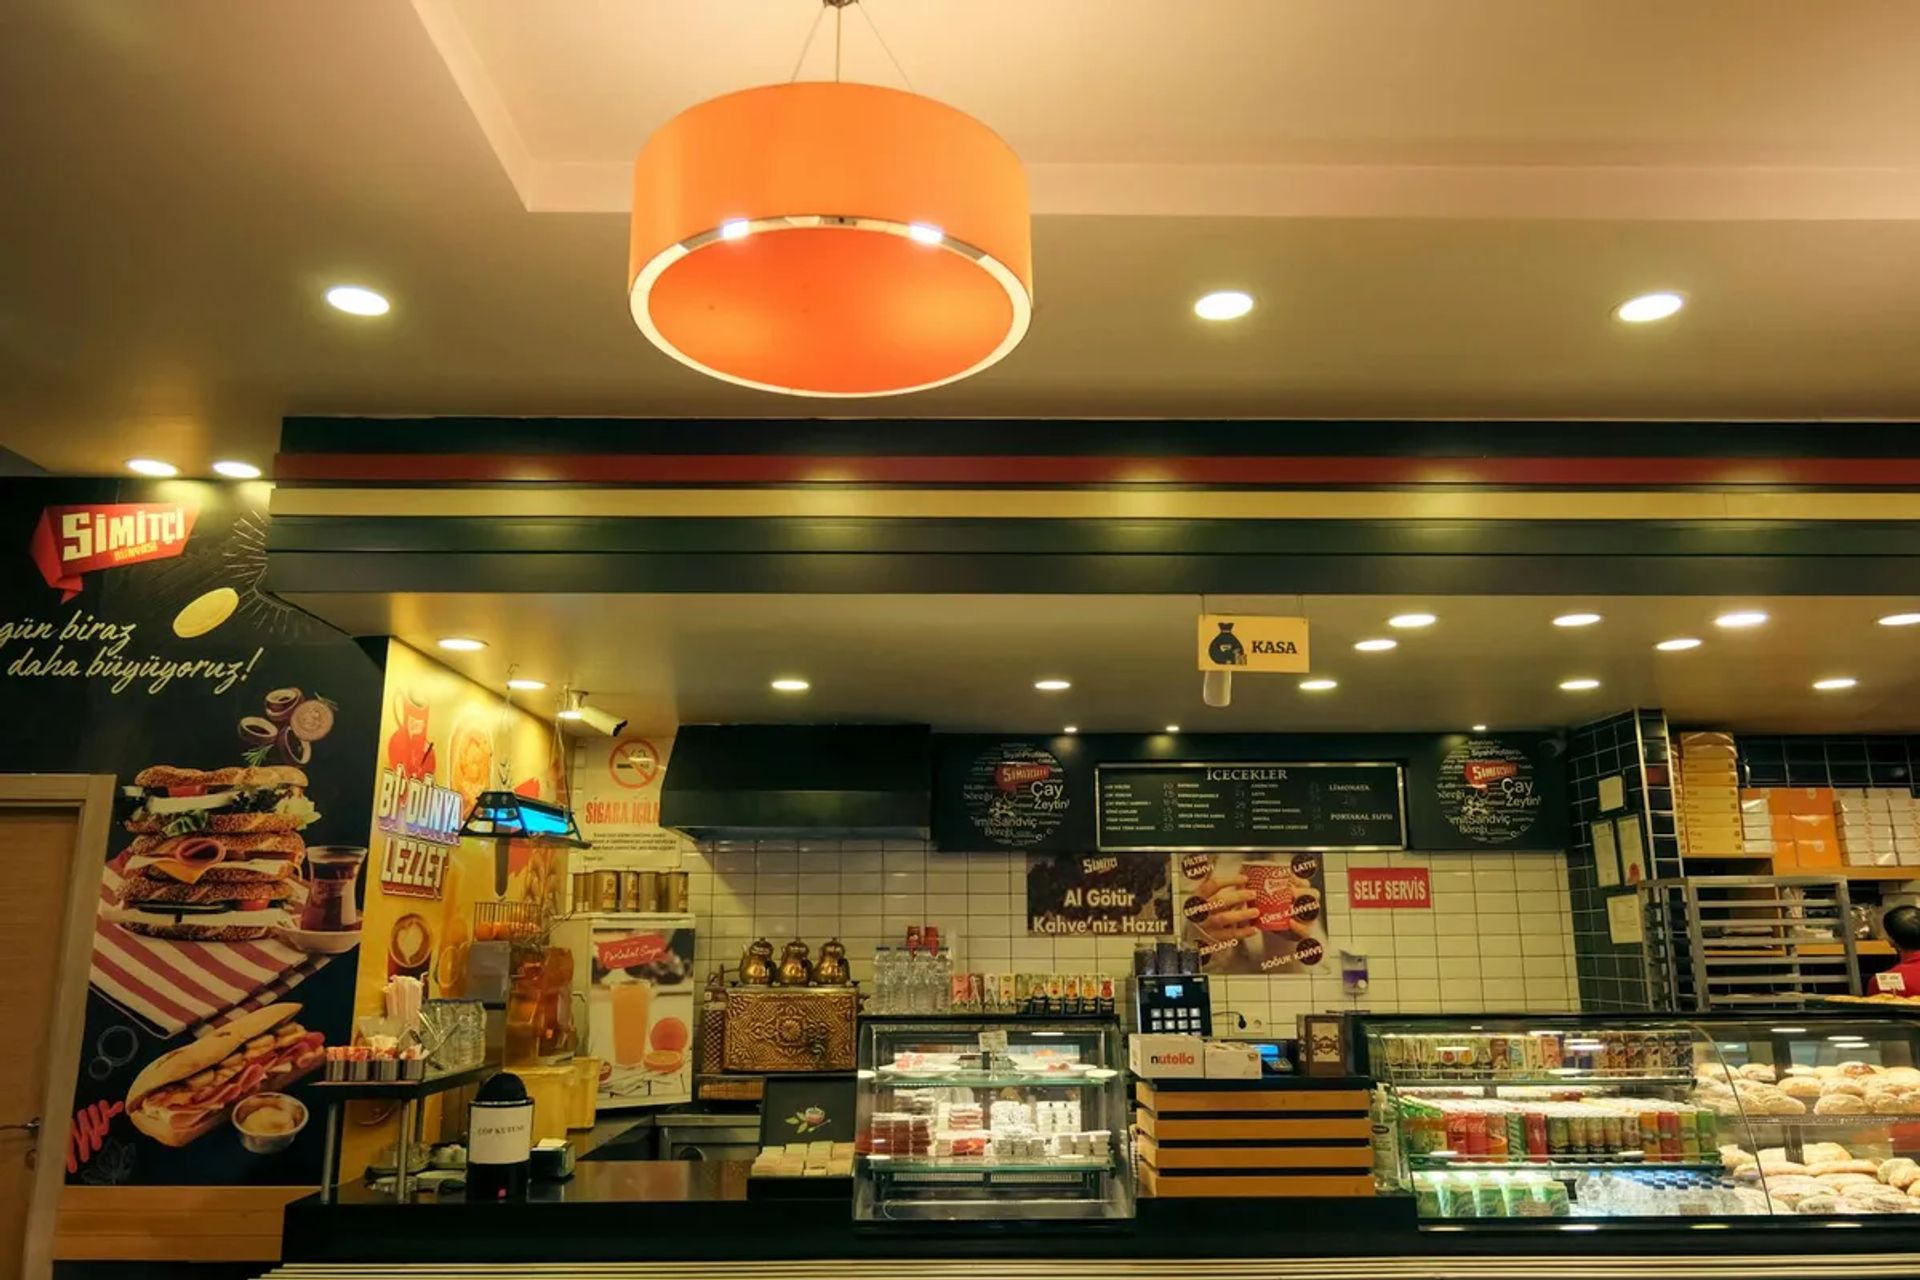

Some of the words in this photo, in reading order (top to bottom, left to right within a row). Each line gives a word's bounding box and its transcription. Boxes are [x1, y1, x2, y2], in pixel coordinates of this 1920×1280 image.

[59, 610, 137, 656] biraz
[1251, 640, 1298, 654] KASA
[7, 645, 80, 677] daha
[85, 646, 264, 695] büyüyoruz!
[1206, 767, 1288, 782] İÇECEKLER
[1031, 781, 1064, 800] Çay
[1501, 778, 1533, 797] Çay
[381, 836, 447, 889] LEZZET
[1292, 860, 1317, 873] LATTE
[1063, 888, 1082, 907] Al
[1086, 888, 1135, 907] Götür
[1354, 880, 1382, 901] SELF
[1384, 876, 1427, 901] SERVİS
[1033, 915, 1117, 933] Kahve'niz
[1122, 915, 1168, 933] Hazır
[1260, 953, 1292, 971] SOĞUK
[1150, 1052, 1195, 1065] nutella
